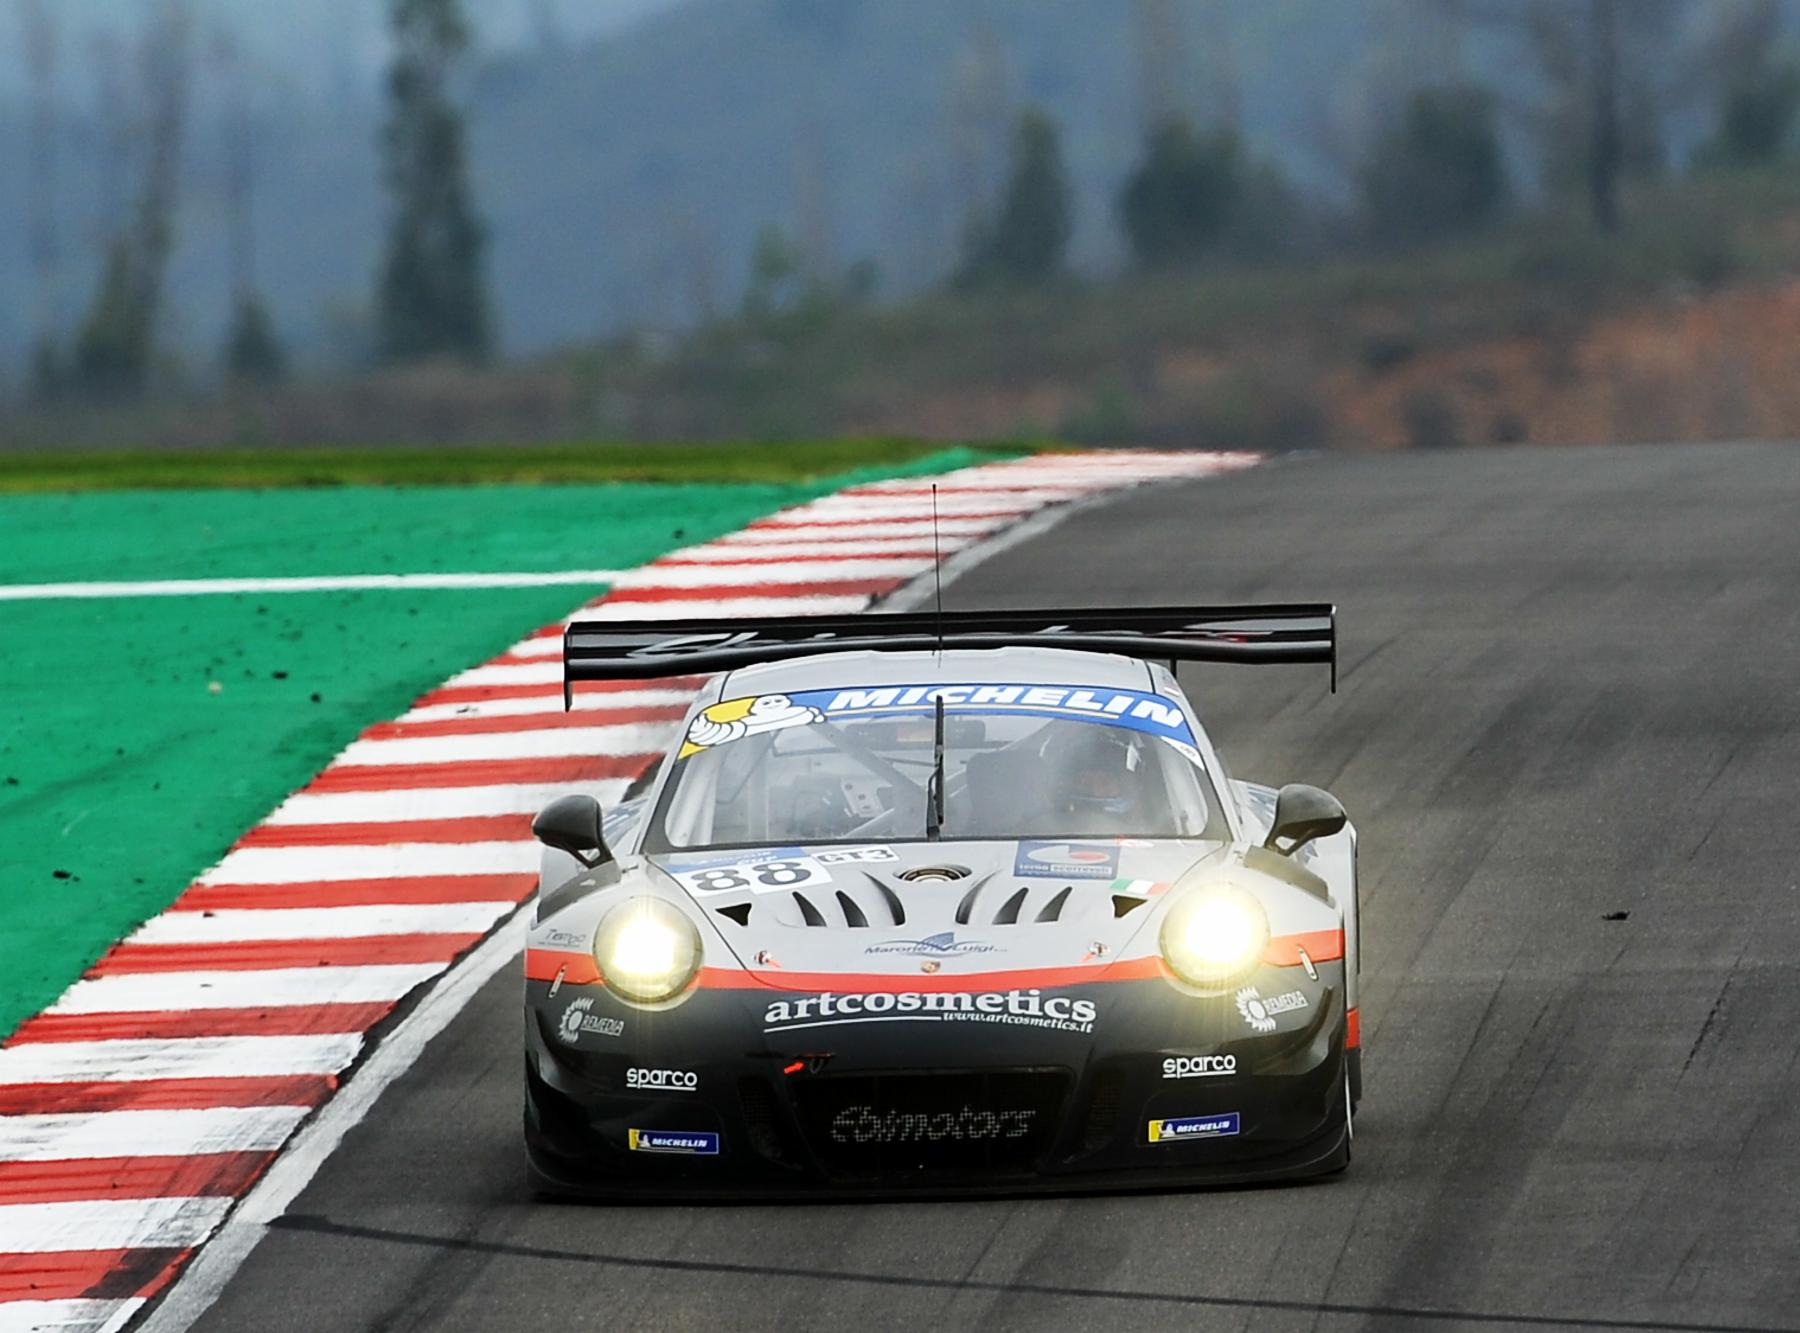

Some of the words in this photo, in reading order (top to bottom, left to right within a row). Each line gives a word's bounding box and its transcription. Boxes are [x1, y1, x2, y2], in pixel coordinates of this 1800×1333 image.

[828, 687, 1185, 727] MICHELIN
[816, 849, 894, 864] GT3
[690, 861, 812, 891] 88
[764, 989, 1097, 1023] artcosmetics
[943, 1011, 1094, 1033] www.artcosmetics.it
[1162, 1055, 1236, 1078] sparco
[626, 1067, 698, 1089] sparco
[1176, 1120, 1230, 1133] MICHELIN
[652, 1138, 707, 1148] MICHELIN
